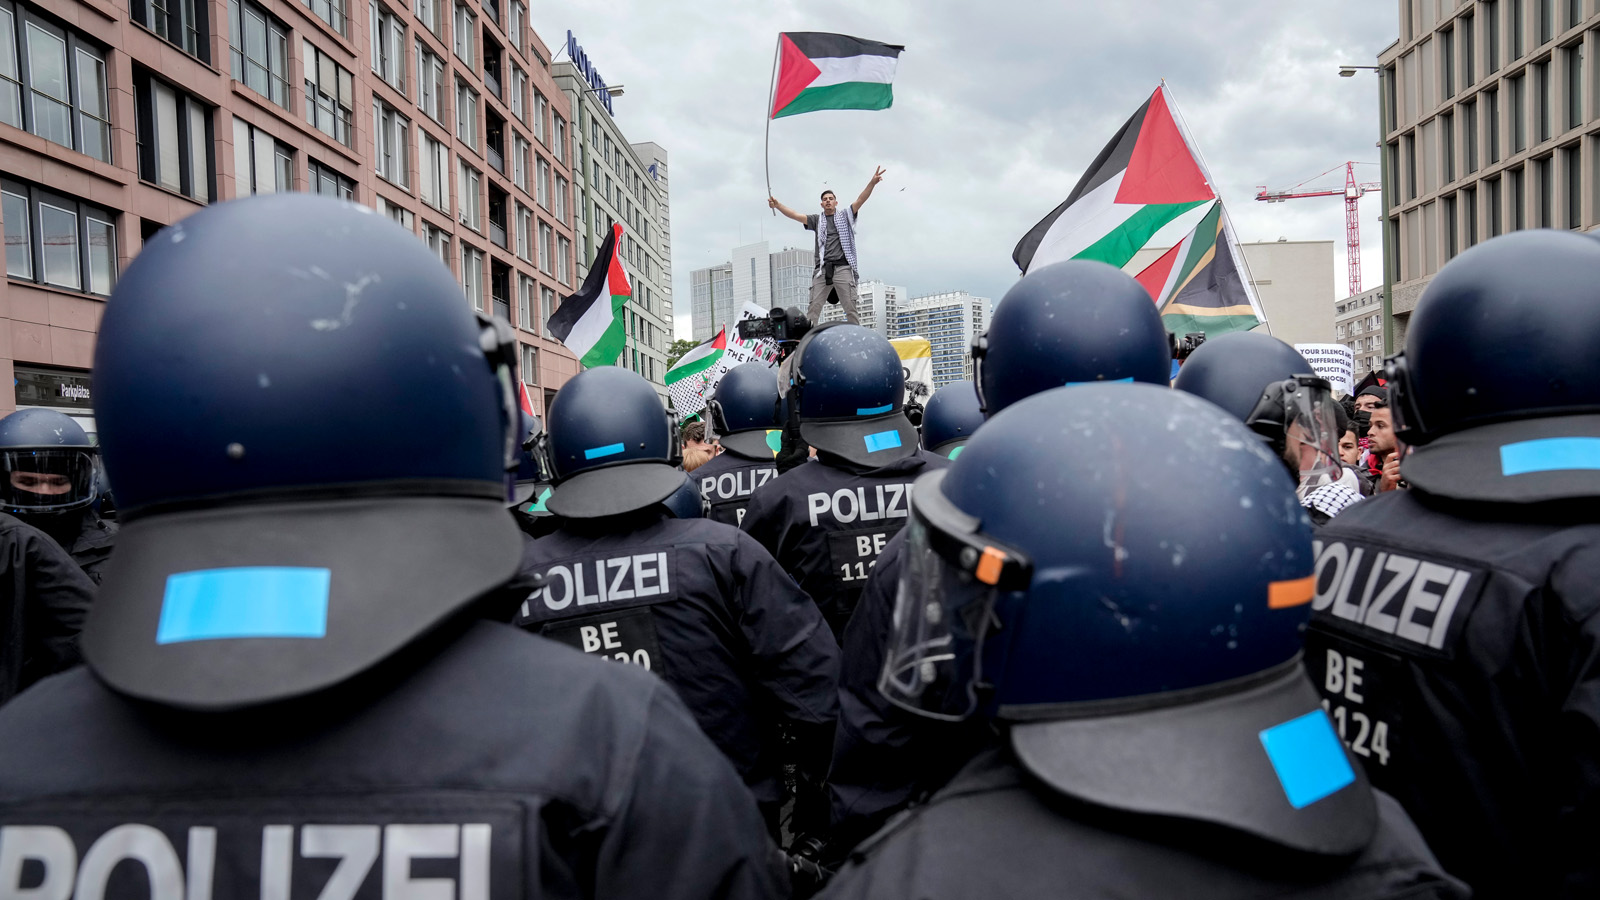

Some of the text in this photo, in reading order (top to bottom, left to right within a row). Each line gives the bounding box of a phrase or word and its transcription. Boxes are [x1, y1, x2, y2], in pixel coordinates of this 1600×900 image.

[727, 349, 745, 363] THE
[61, 383, 90, 401] Parkplätze
[1320, 375, 1346, 383] ENOCIDE
[701, 468, 779, 500] POLIZ
[808, 483, 914, 527] POLIZ
[856, 533, 886, 557] BE
[840, 560, 877, 581] 11
[1312, 540, 1472, 650] OLIZEI
[580, 621, 622, 653] BE
[1325, 648, 1364, 704] BE
[1321, 699, 1390, 766] 124
